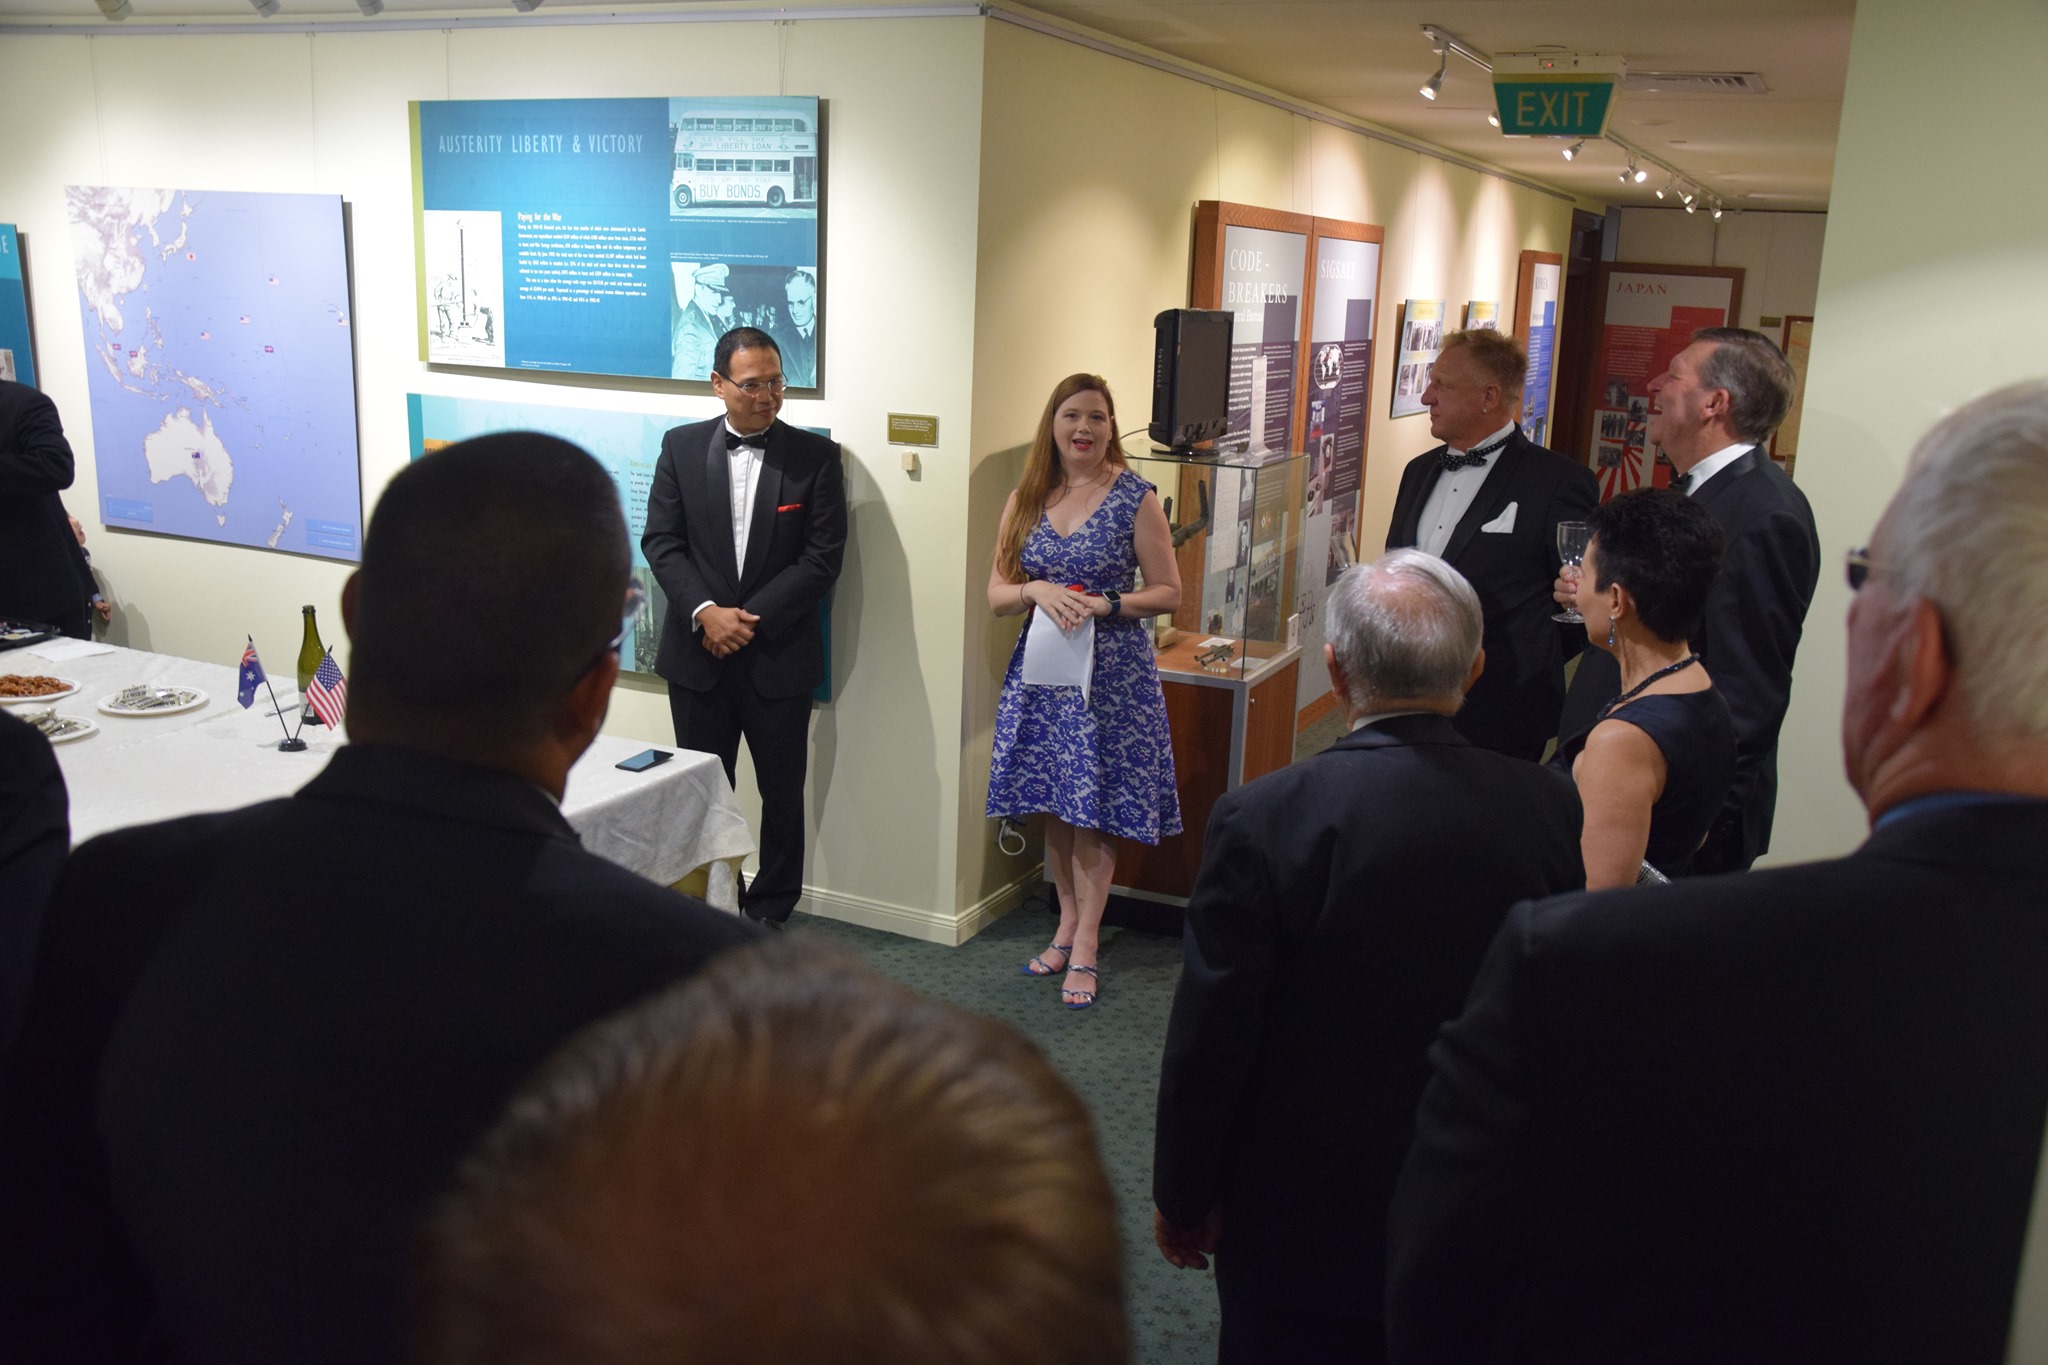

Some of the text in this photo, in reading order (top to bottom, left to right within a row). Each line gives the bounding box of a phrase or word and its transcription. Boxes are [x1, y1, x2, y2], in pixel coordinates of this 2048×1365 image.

[1517, 92, 1590, 127] EXIT
[439, 134, 643, 153] AUSTERITY LIBERTY & VICTORY
[700, 184, 720, 198] BUY
[518, 212, 533, 223] Paying
[543, 213, 551, 222] the
[552, 213, 562, 222] War
[1230, 249, 1262, 272] CODE
[1320, 259, 1357, 281] SIGSALY
[1228, 281, 1288, 304] BREAKERS
[1616, 281, 1667, 295] JAPAN
